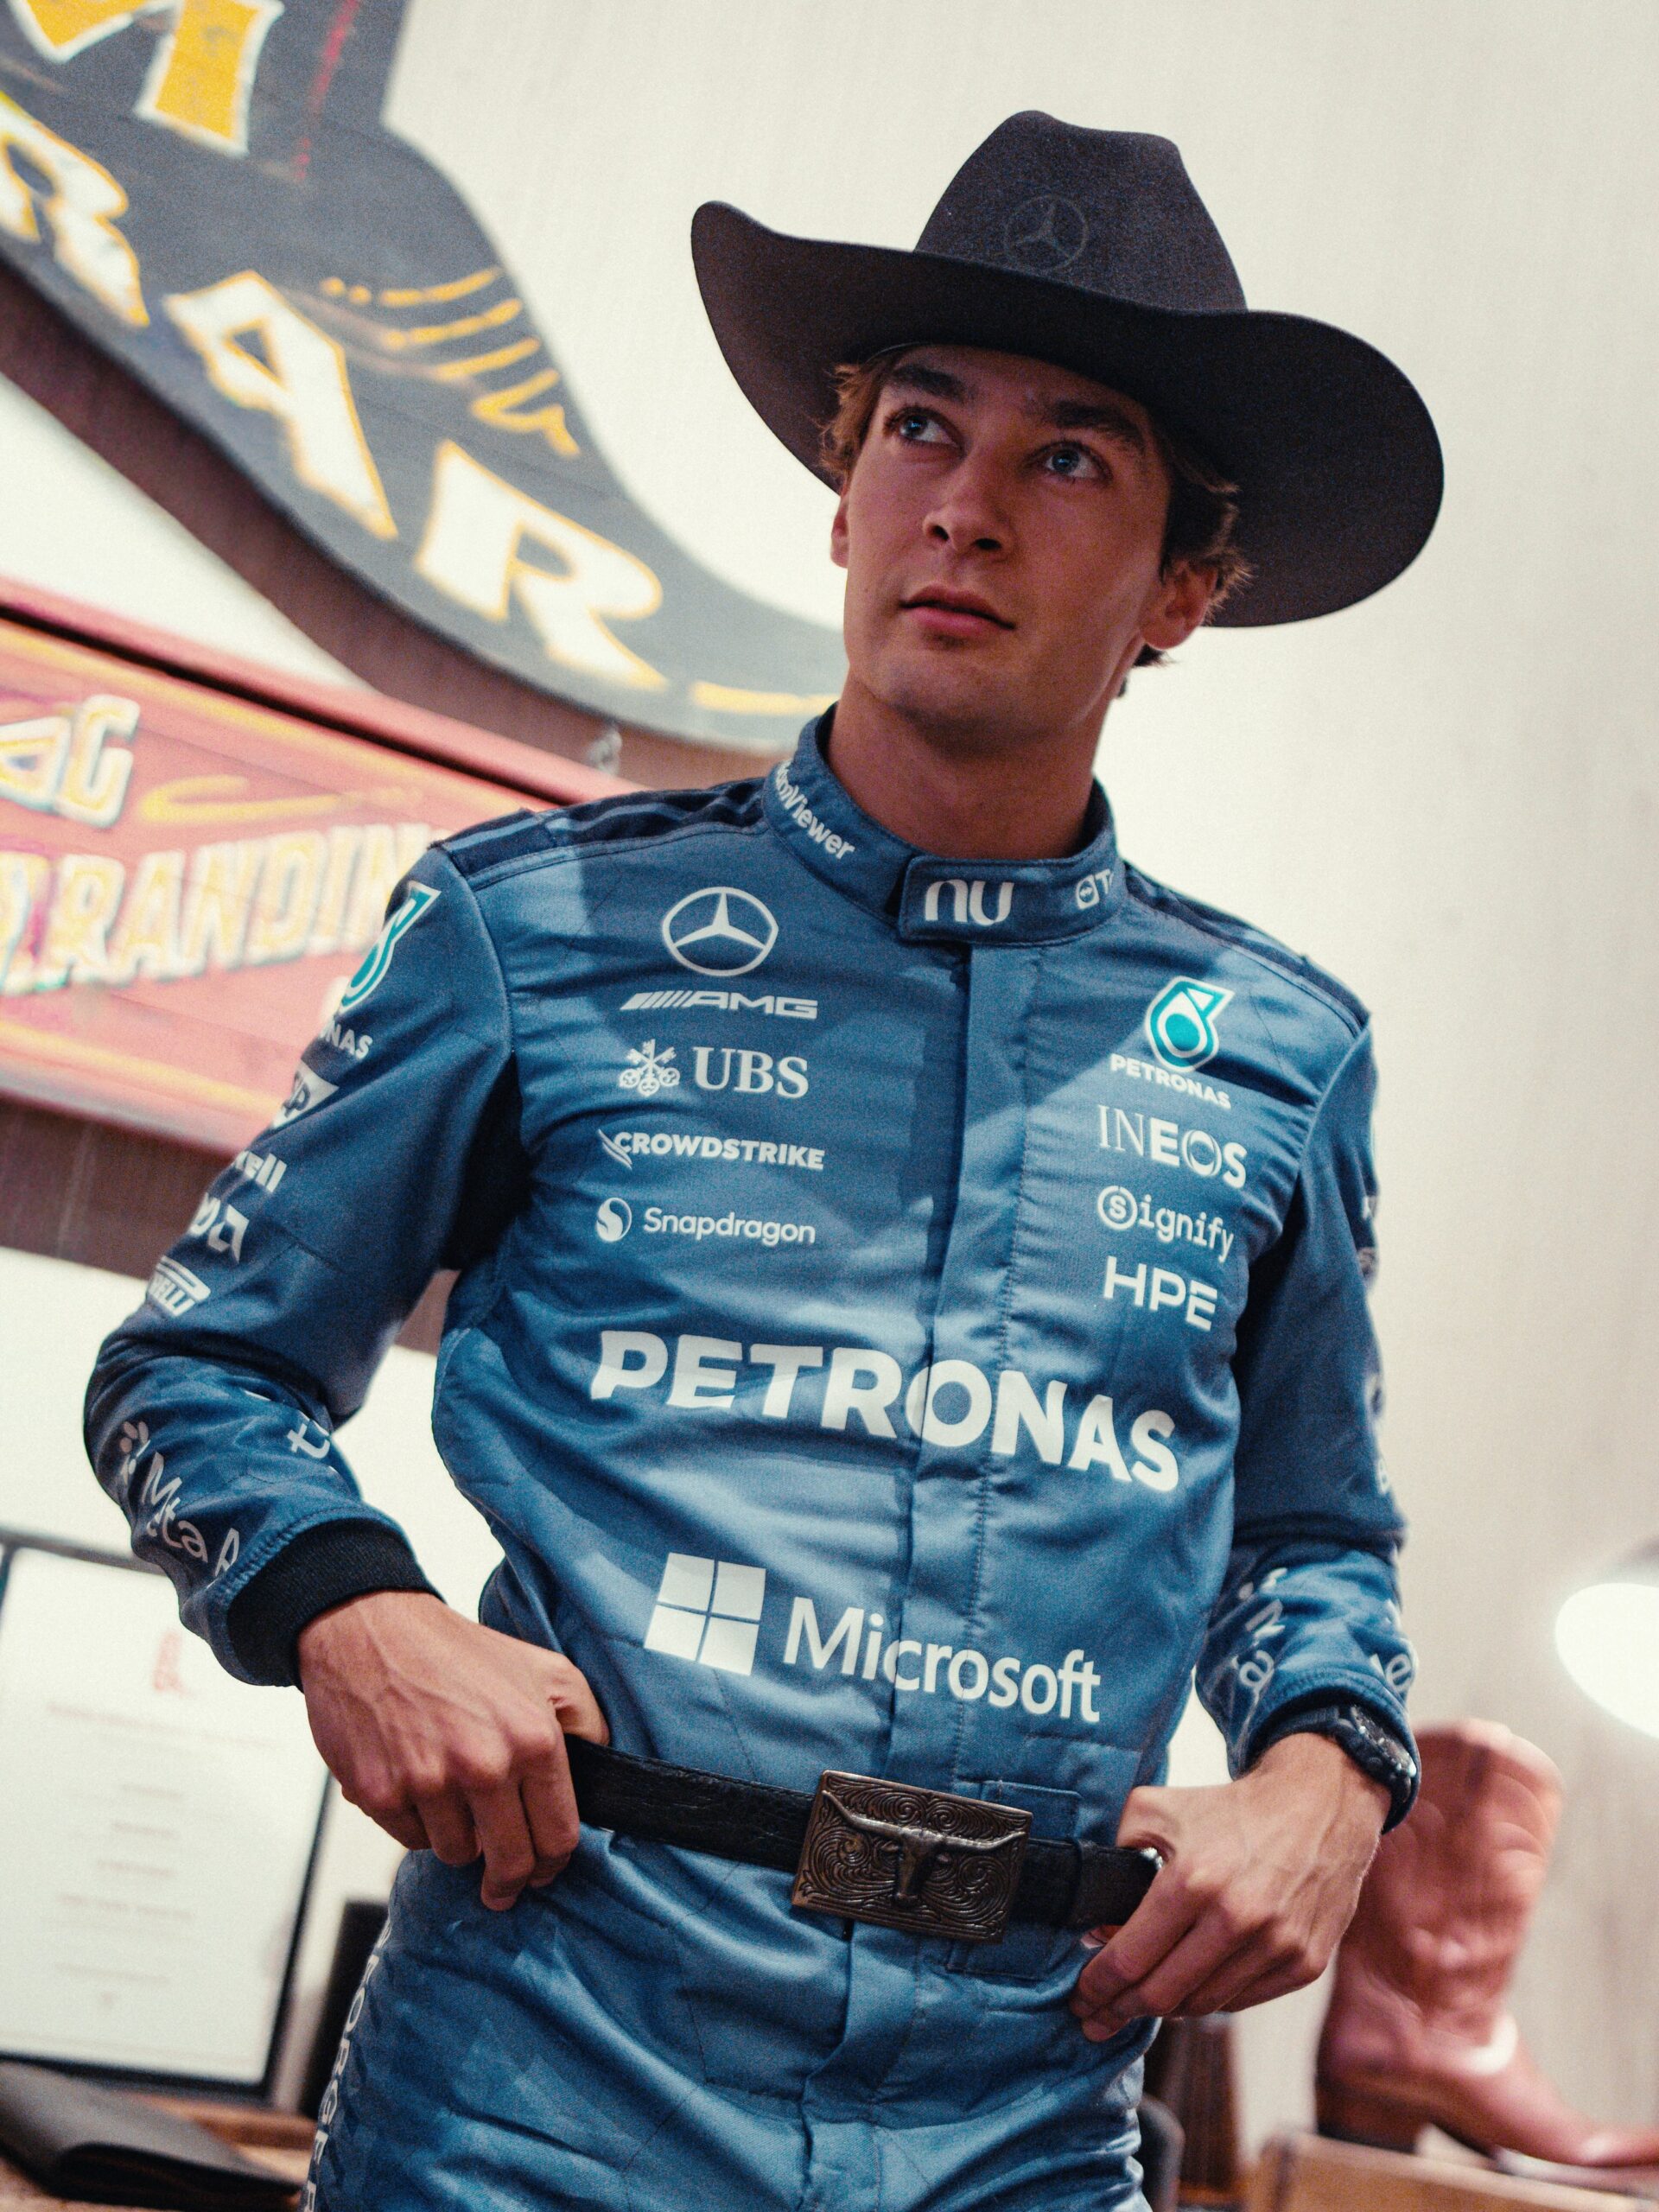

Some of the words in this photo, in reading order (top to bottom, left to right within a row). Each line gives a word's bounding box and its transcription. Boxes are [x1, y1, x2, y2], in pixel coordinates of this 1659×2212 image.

[688, 990, 819, 1020] AMG
[691, 1046, 810, 1099] UBS
[1109, 1053, 1232, 1110] PETRONAS
[613, 1131, 826, 1171] CROWDSTRIKE
[1096, 1104, 1248, 1190] INEOS
[643, 1206, 817, 1248] Snapdragon
[1103, 1255, 1218, 1332] HPE
[589, 1329, 1181, 1493] PETRONAS
[782, 1595, 1103, 1725] Microsoft
